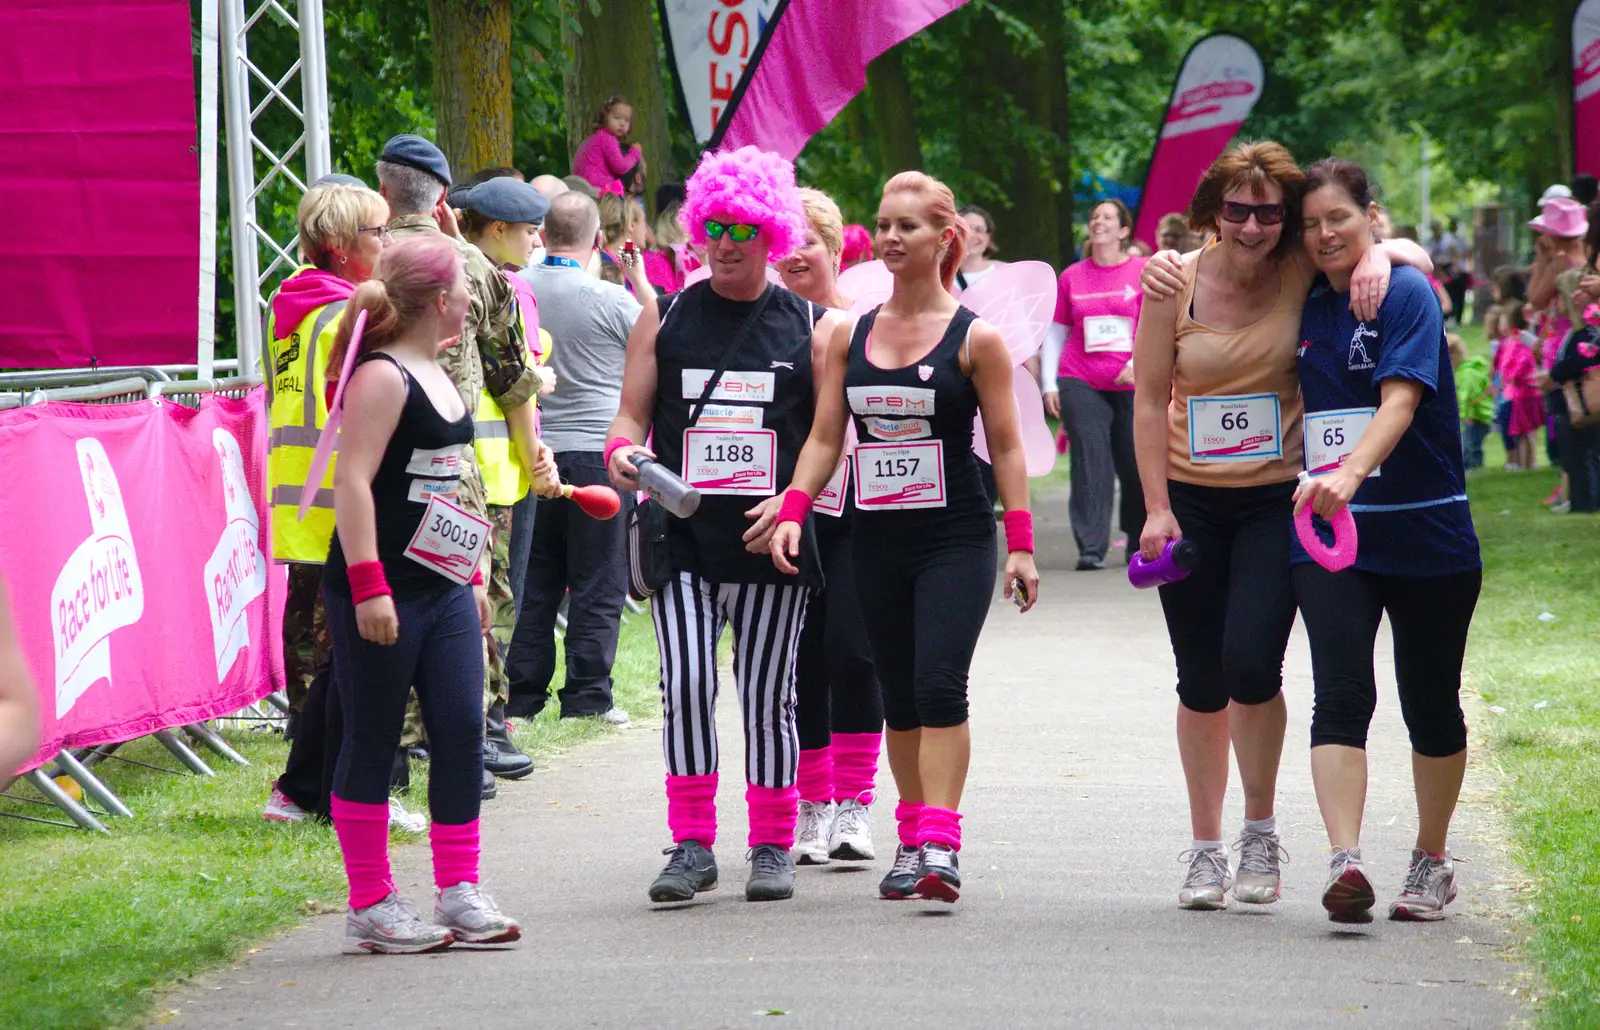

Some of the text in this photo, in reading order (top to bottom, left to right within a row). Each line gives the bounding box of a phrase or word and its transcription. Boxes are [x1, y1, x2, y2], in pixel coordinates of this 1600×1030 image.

[707, 0, 750, 133] ES
[866, 396, 926, 409] PBM
[1221, 412, 1249, 431] 66
[1323, 427, 1345, 446] 65
[704, 444, 754, 462] 1188
[874, 458, 920, 478] 1157
[430, 513, 479, 551] 30019
[59, 545, 132, 658] Race for Life
